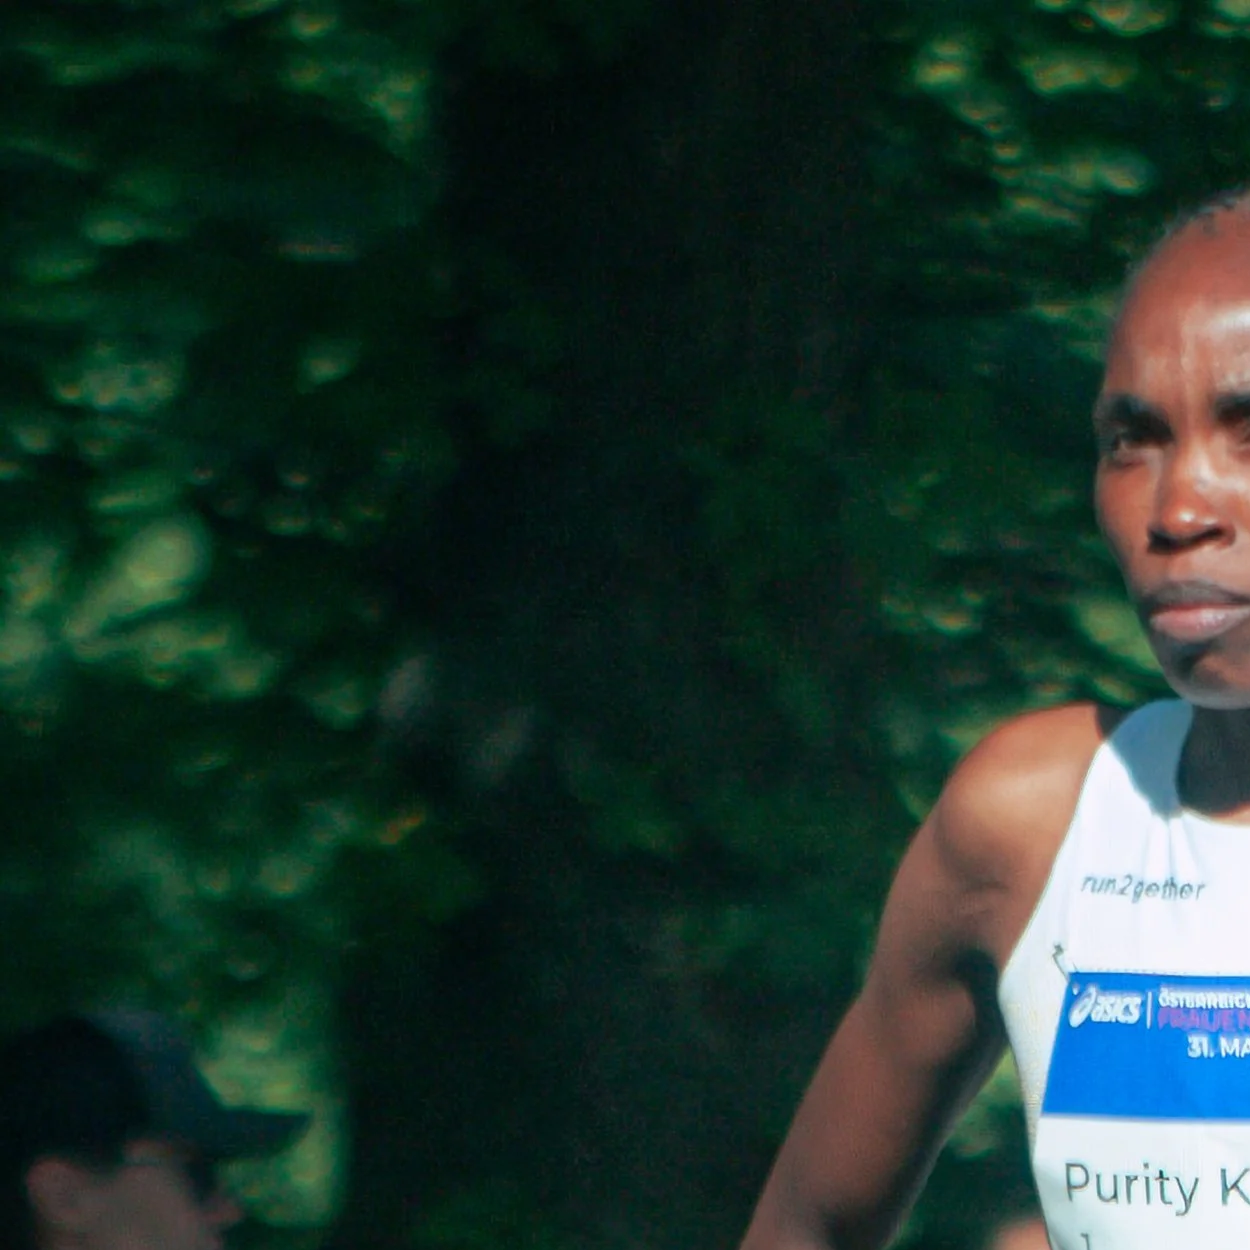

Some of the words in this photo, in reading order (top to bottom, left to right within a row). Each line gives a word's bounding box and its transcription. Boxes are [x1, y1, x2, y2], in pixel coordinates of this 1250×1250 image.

[1081, 873, 1206, 904] run2gether
[1187, 1034, 1215, 1059] 31.
[1065, 1162, 1199, 1217] Purity
